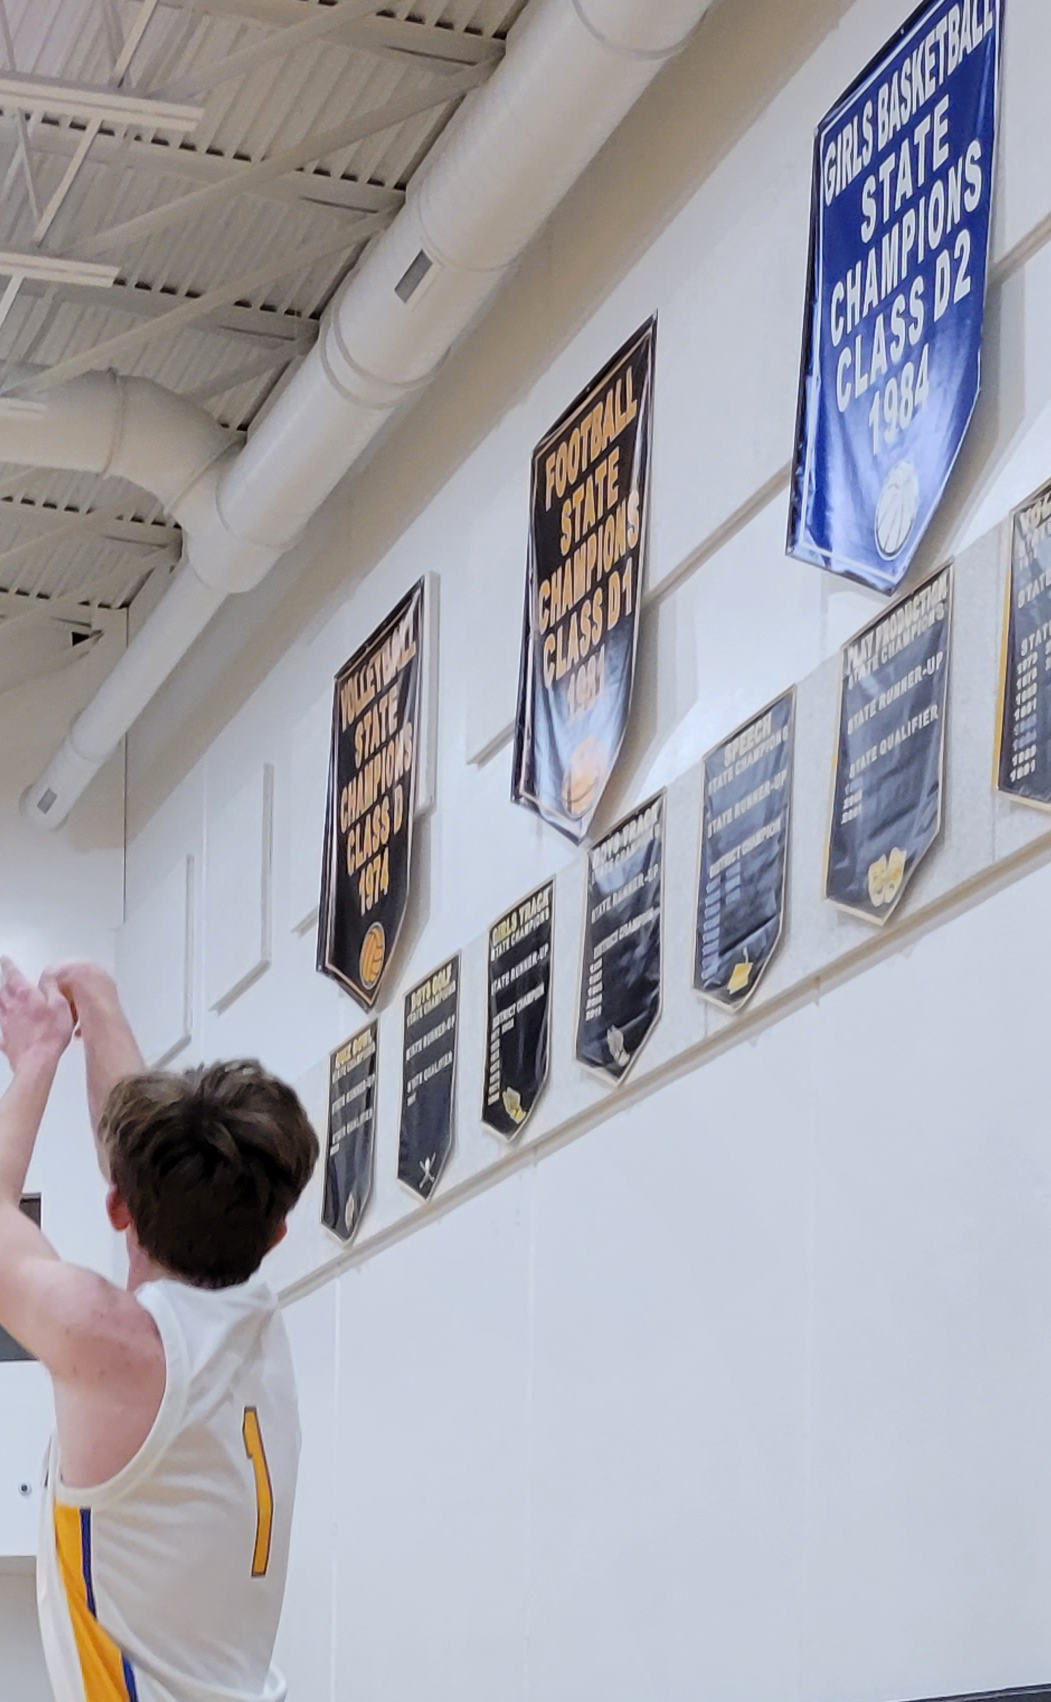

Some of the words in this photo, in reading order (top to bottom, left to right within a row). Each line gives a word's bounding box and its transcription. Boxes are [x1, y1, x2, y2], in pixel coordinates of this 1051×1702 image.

[823, 98, 873, 207] GIRLS
[877, 0, 993, 152] BASKETBALL
[861, 94, 950, 244] STATE
[830, 139, 982, 347] CHAMPIONS
[836, 275, 925, 413] CLASS
[933, 228, 972, 323] D2
[545, 365, 638, 512] FOOTBALL
[868, 343, 931, 456] 1984
[560, 445, 620, 557] STATE
[538, 489, 640, 636] CHAMPIONS
[340, 602, 417, 734] VOLLEYBALL
[542, 586, 603, 690] CLASS
[607, 556, 634, 631] D1
[846, 626, 875, 674] PLAY
[874, 571, 948, 652] PRODUCTION
[847, 648, 880, 691] STATE
[880, 602, 945, 668] CHAMPIONS
[354, 683, 398, 770] STATE
[724, 712, 772, 767] SPEECH
[847, 700, 878, 736] STATE
[878, 650, 945, 713] RUNNER-UP
[847, 745, 879, 781] STATE
[879, 704, 939, 757] QUALIFIER
[340, 722, 413, 834] CHAMPIONS
[346, 795, 390, 877] CLASS
[393, 784, 404, 836] D
[358, 847, 390, 917] 1974
[242, 1406, 274, 1578] 1
